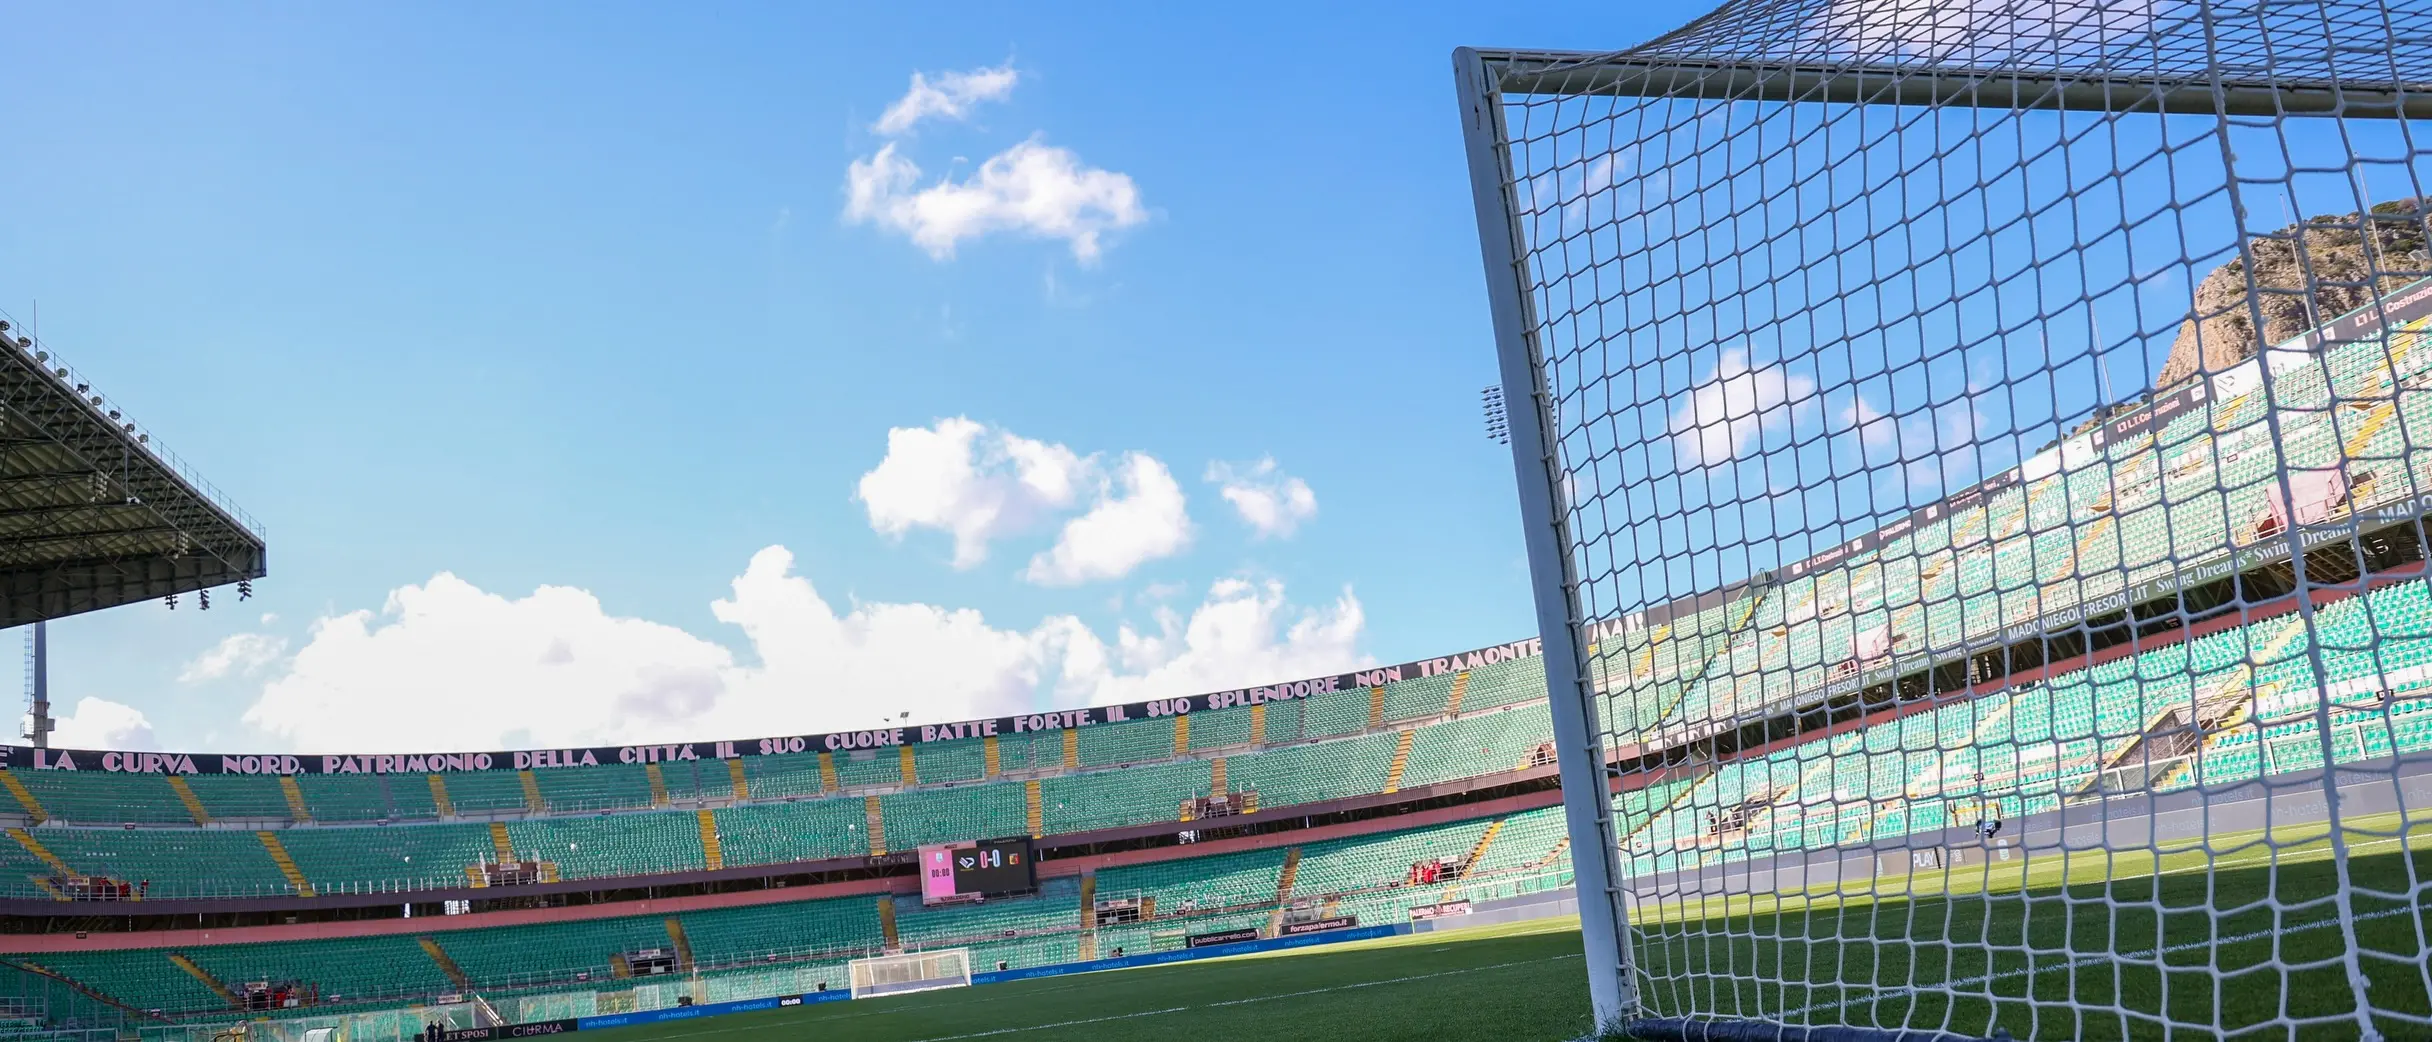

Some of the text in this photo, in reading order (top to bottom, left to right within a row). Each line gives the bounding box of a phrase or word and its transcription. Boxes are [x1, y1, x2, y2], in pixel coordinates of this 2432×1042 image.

[2254, 540, 2292, 562] Swin
[33, 748, 77, 771] LA
[102, 752, 199, 774] CURVA
[322, 753, 493, 774] PATRIMONIO
[513, 749, 599, 769] DELLA
[716, 741, 740, 758] IL
[759, 736, 805, 755] SUO
[824, 728, 905, 750] CUORE
[921, 719, 998, 742] BATTE
[1013, 709, 1097, 733] FORTE.
[1106, 705, 1130, 723] IL
[1147, 697, 1191, 717] SUO
[1207, 676, 1339, 710] SPLENDORE
[1355, 666, 1402, 688] NON
[979, 848, 1001, 869] 0-0
[1913, 852, 1935, 868] PLAY
[1290, 919, 1348, 933] forzapalermo.it
[1157, 952, 1194, 962] nh-hotels.it
[1092, 961, 1129, 971] nh-hotels.it
[1026, 968, 1064, 978] nh-hotels.it
[732, 1001, 772, 1012] nh-hotels.it
[781, 998, 801, 1006] 00:00
[659, 1009, 700, 1021] nh-hotels.it
[586, 1017, 628, 1028] nh-hotels.it
[461, 1029, 489, 1040] SPOSI
